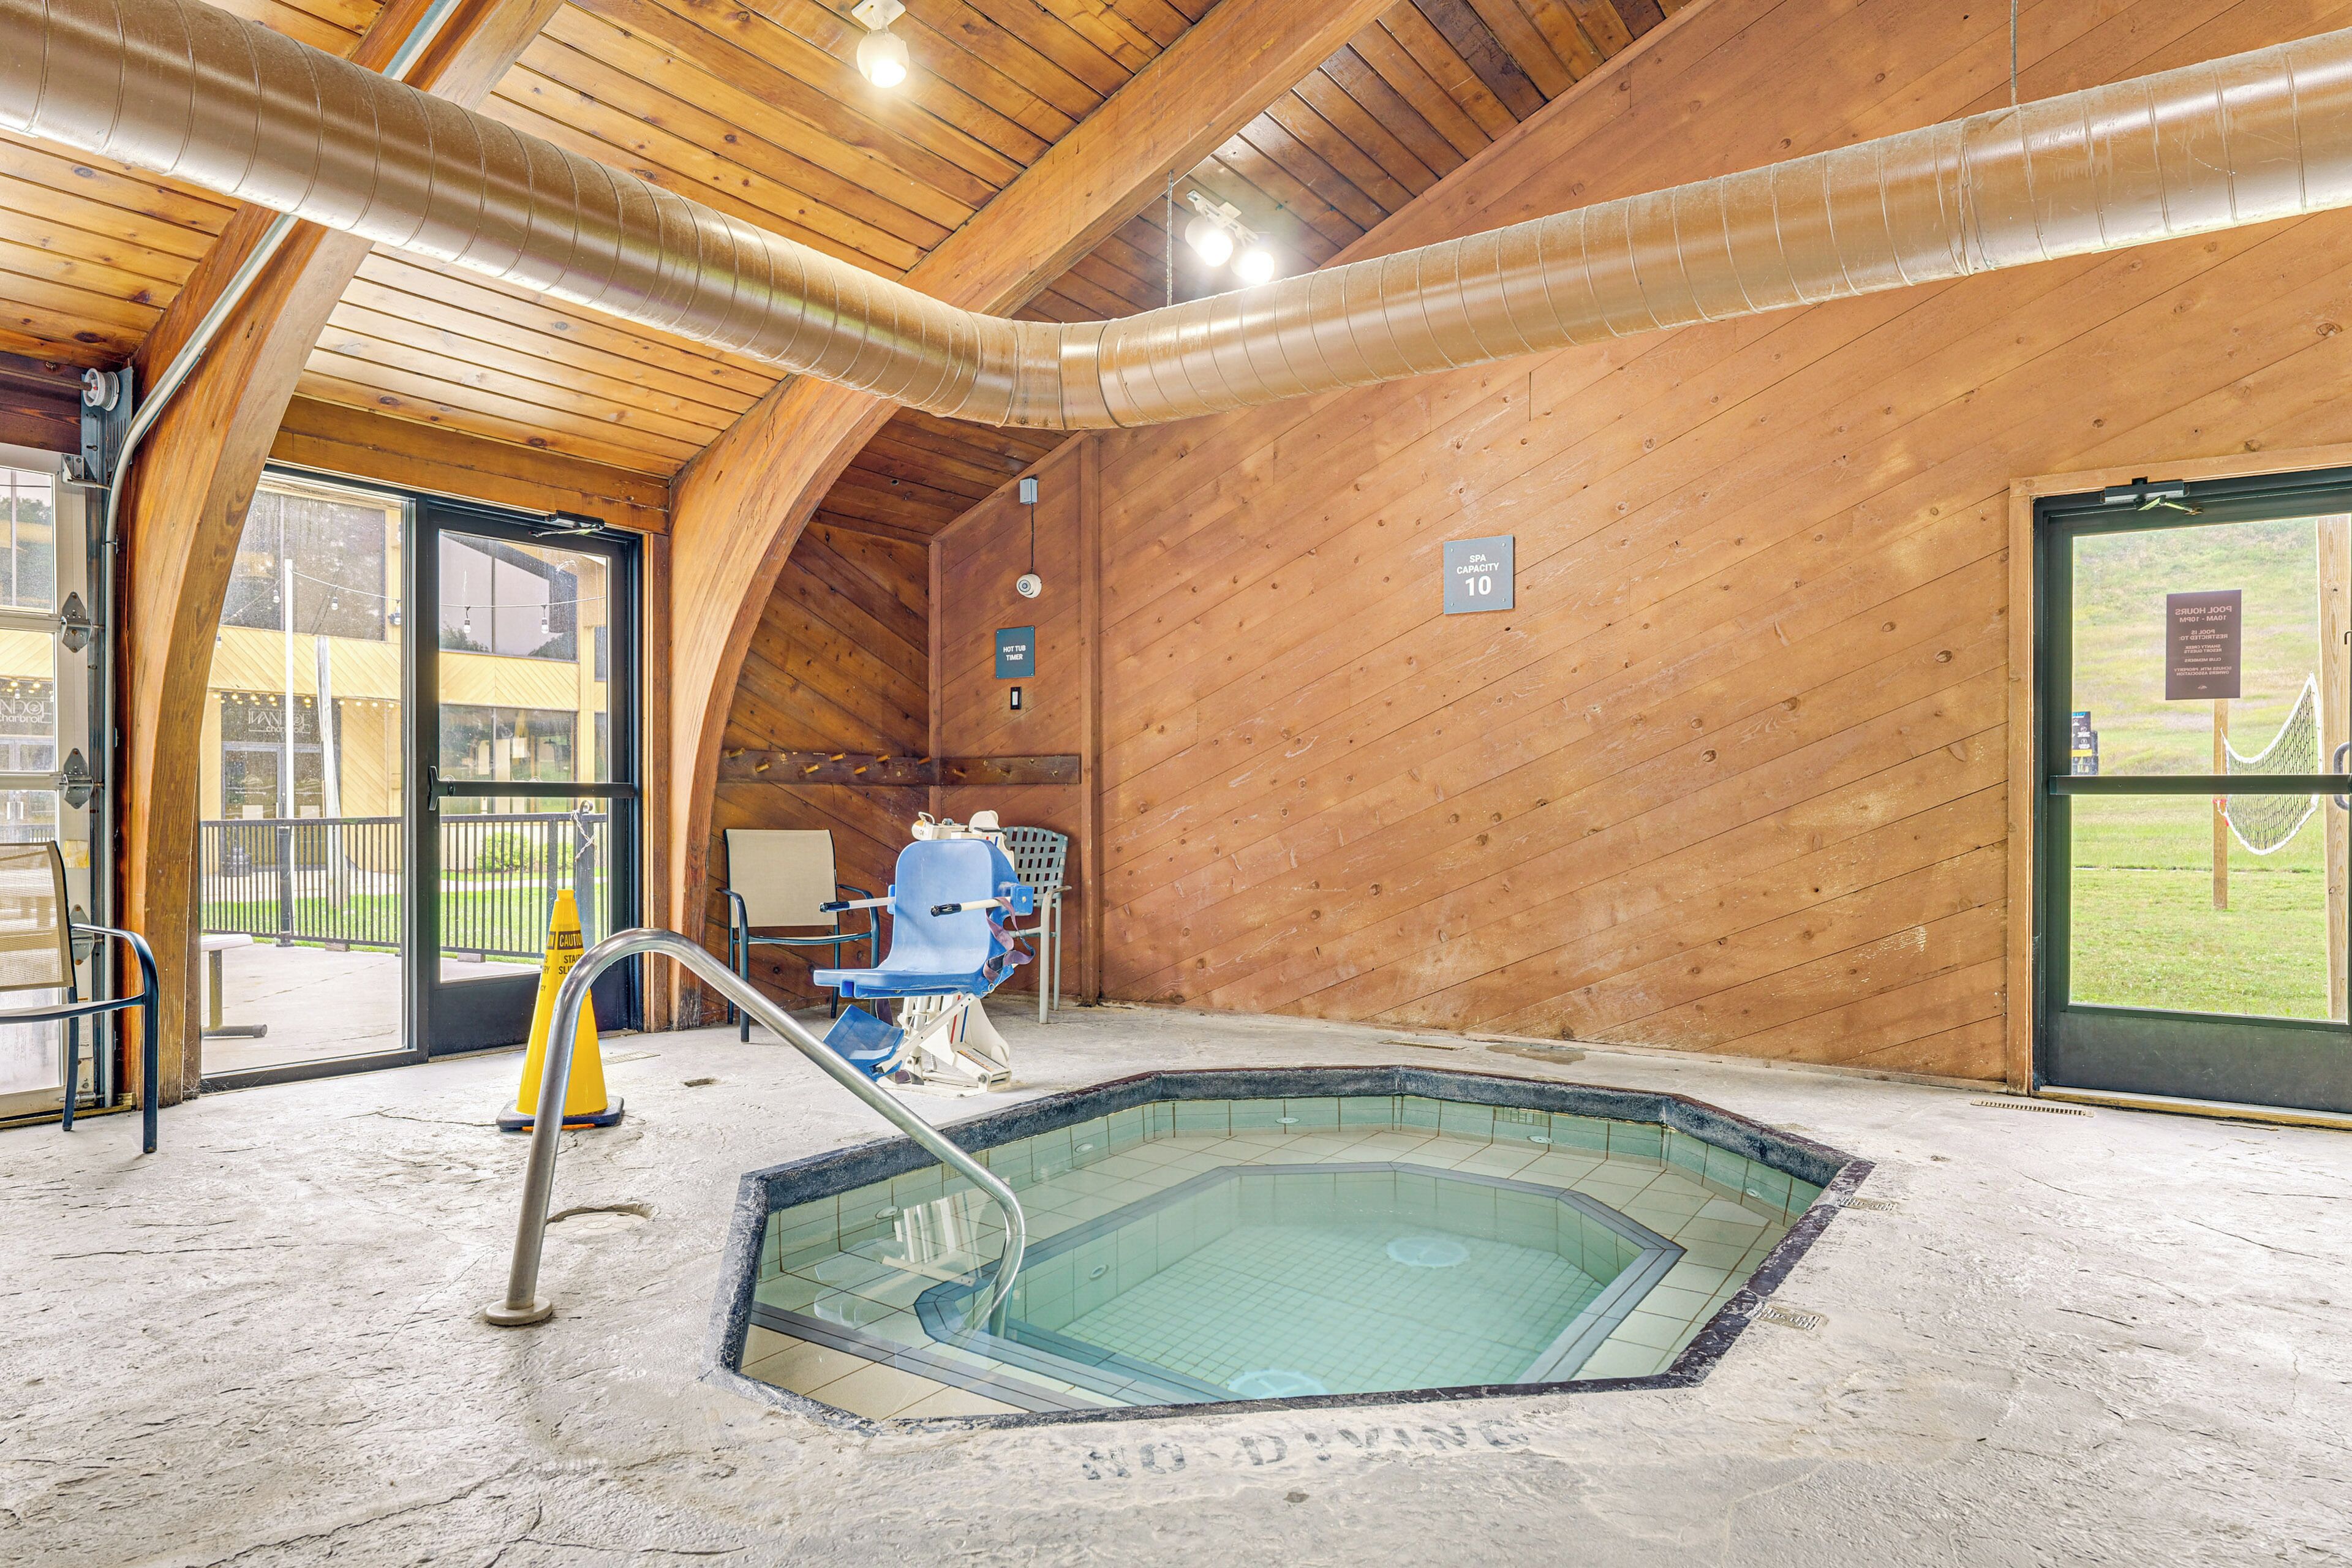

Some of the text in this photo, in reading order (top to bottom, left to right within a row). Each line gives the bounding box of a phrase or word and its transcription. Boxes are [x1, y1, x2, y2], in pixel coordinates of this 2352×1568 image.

[1469, 554, 1487, 563] SPA
[1457, 562, 1499, 575] CAPACITY
[1465, 575, 1492, 597] 10
[0, 714, 43, 723] harbroil
[559, 933, 583, 947] CAUTIO
